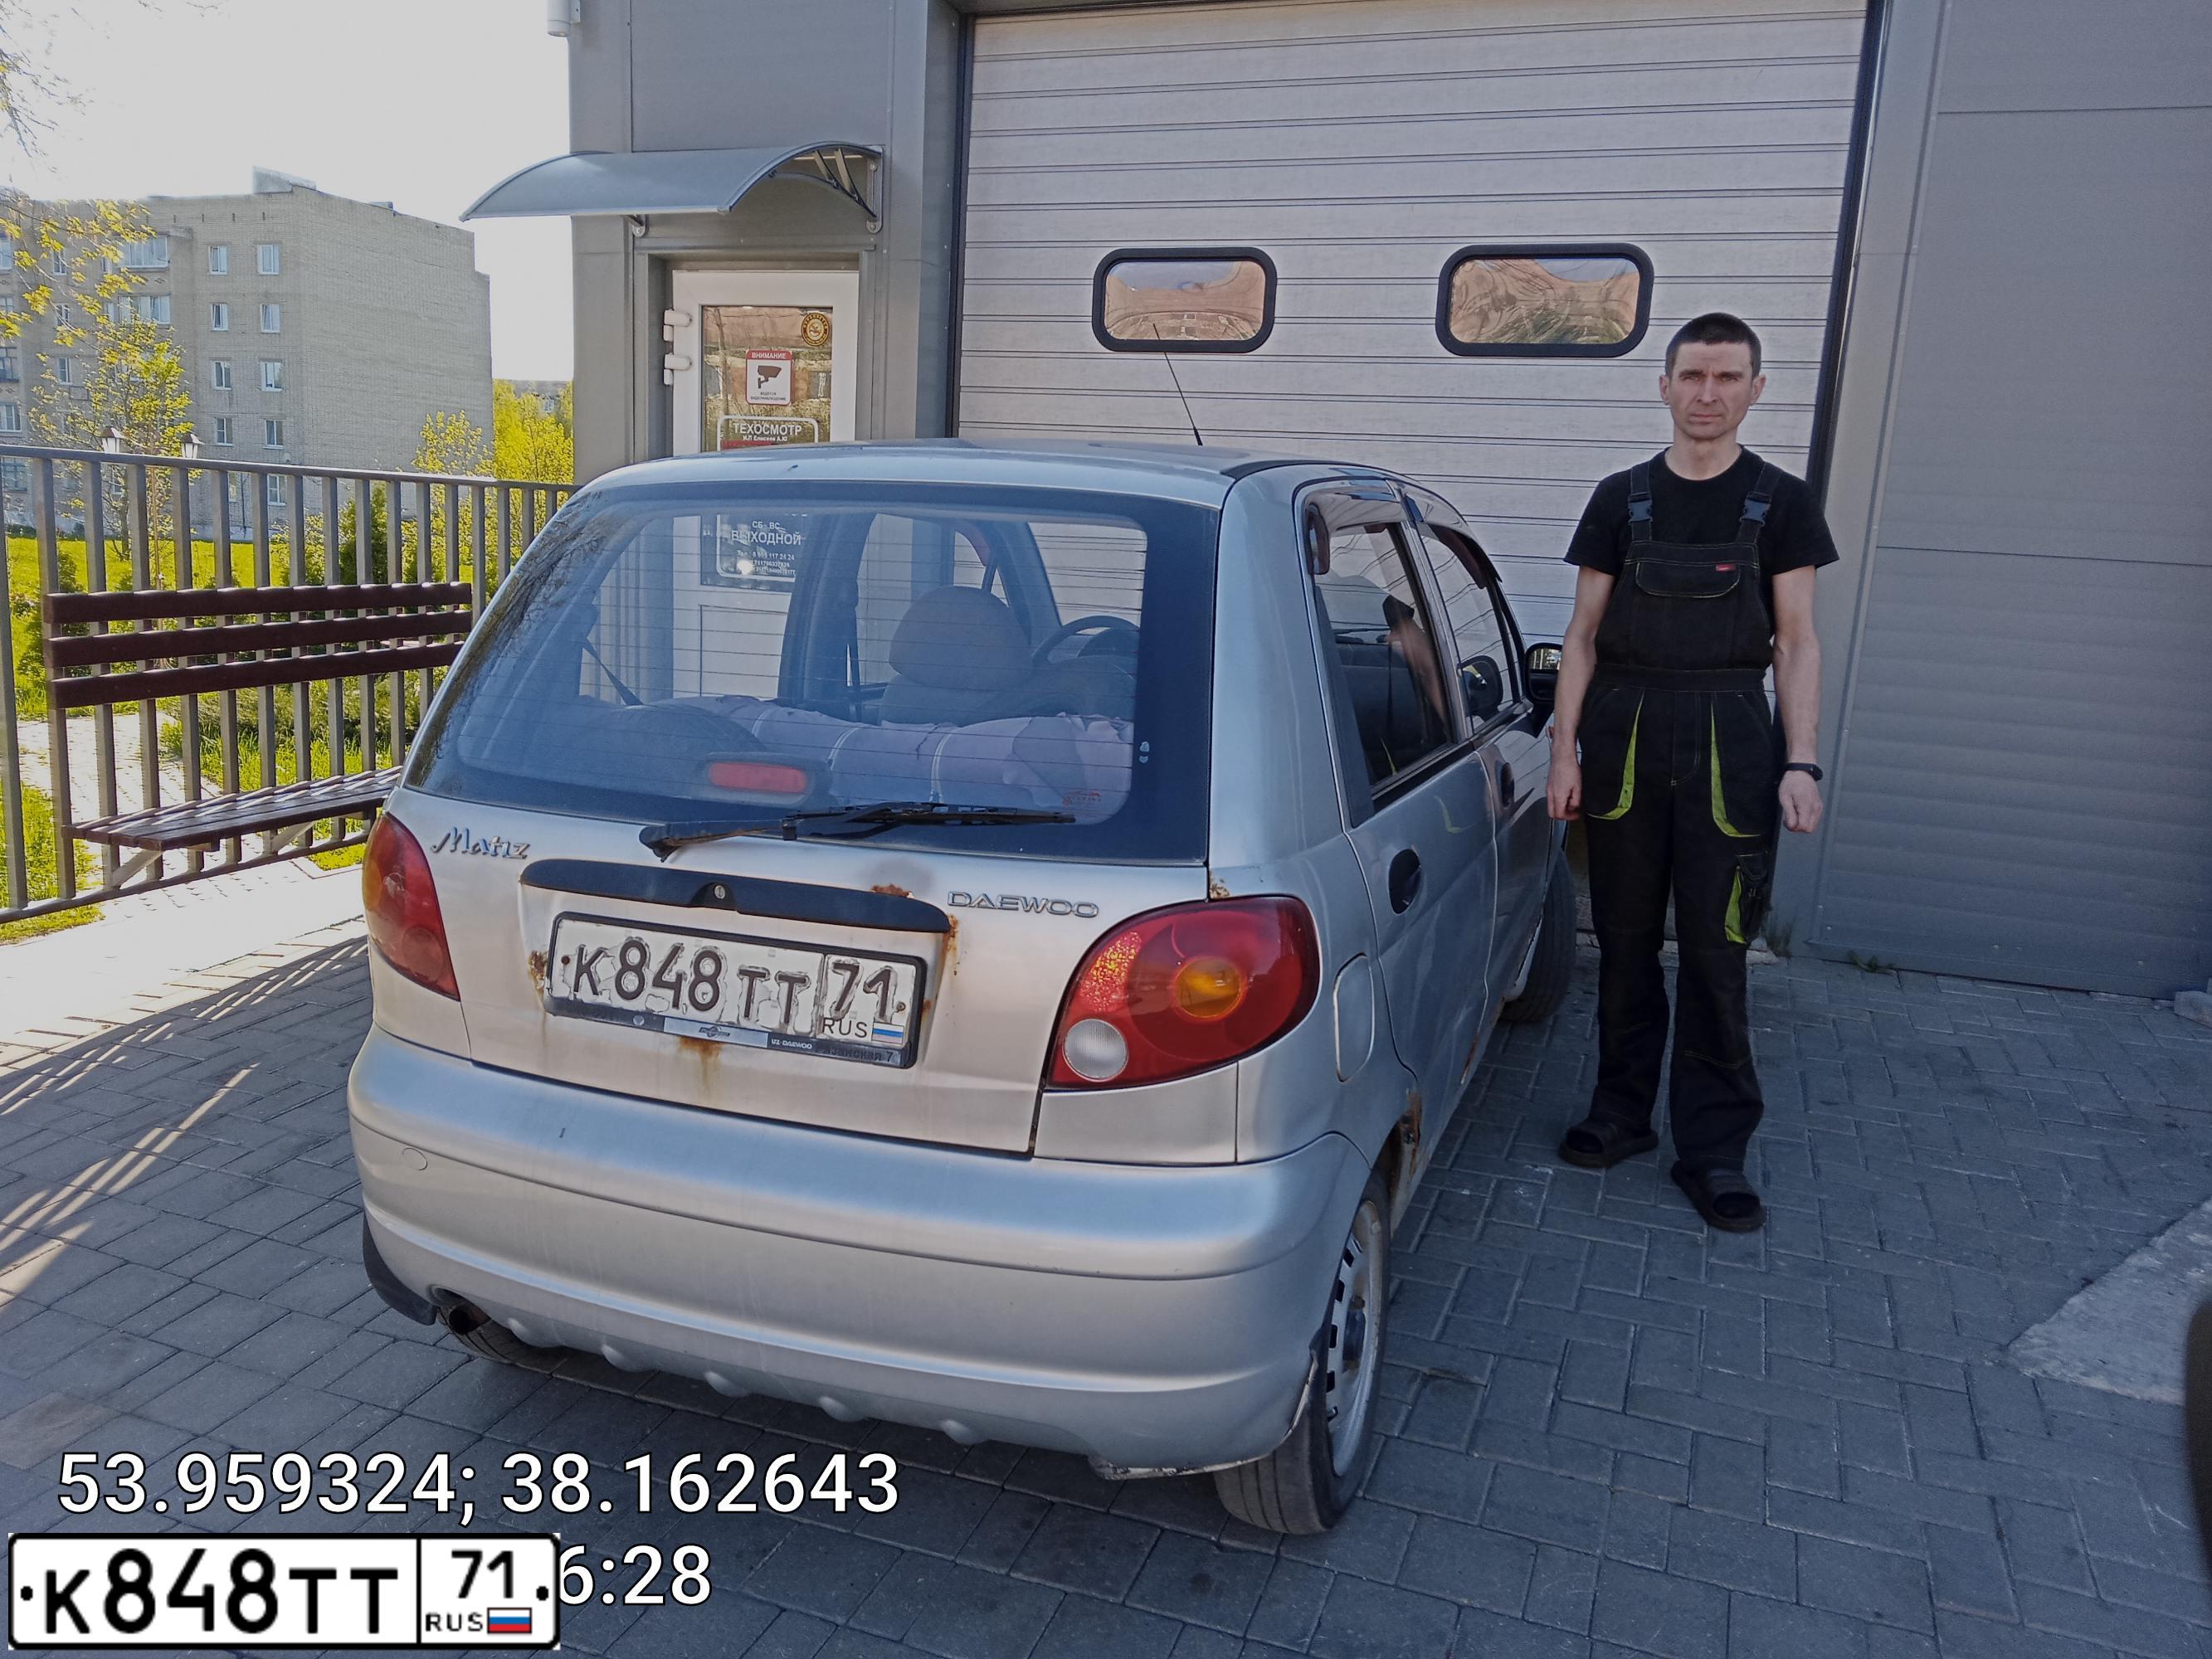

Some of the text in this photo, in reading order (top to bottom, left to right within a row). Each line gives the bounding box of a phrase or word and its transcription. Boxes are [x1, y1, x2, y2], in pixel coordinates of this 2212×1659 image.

[733, 422, 802, 435] ТЕХОСМОТР
[731, 530, 801, 545] ВЫХОДНОЙ
[430, 826, 531, 859] Matiz
[947, 891, 1099, 918] DAEWOO
[831, 960, 892, 1019] 71
[822, 1017, 868, 1038] RUS
